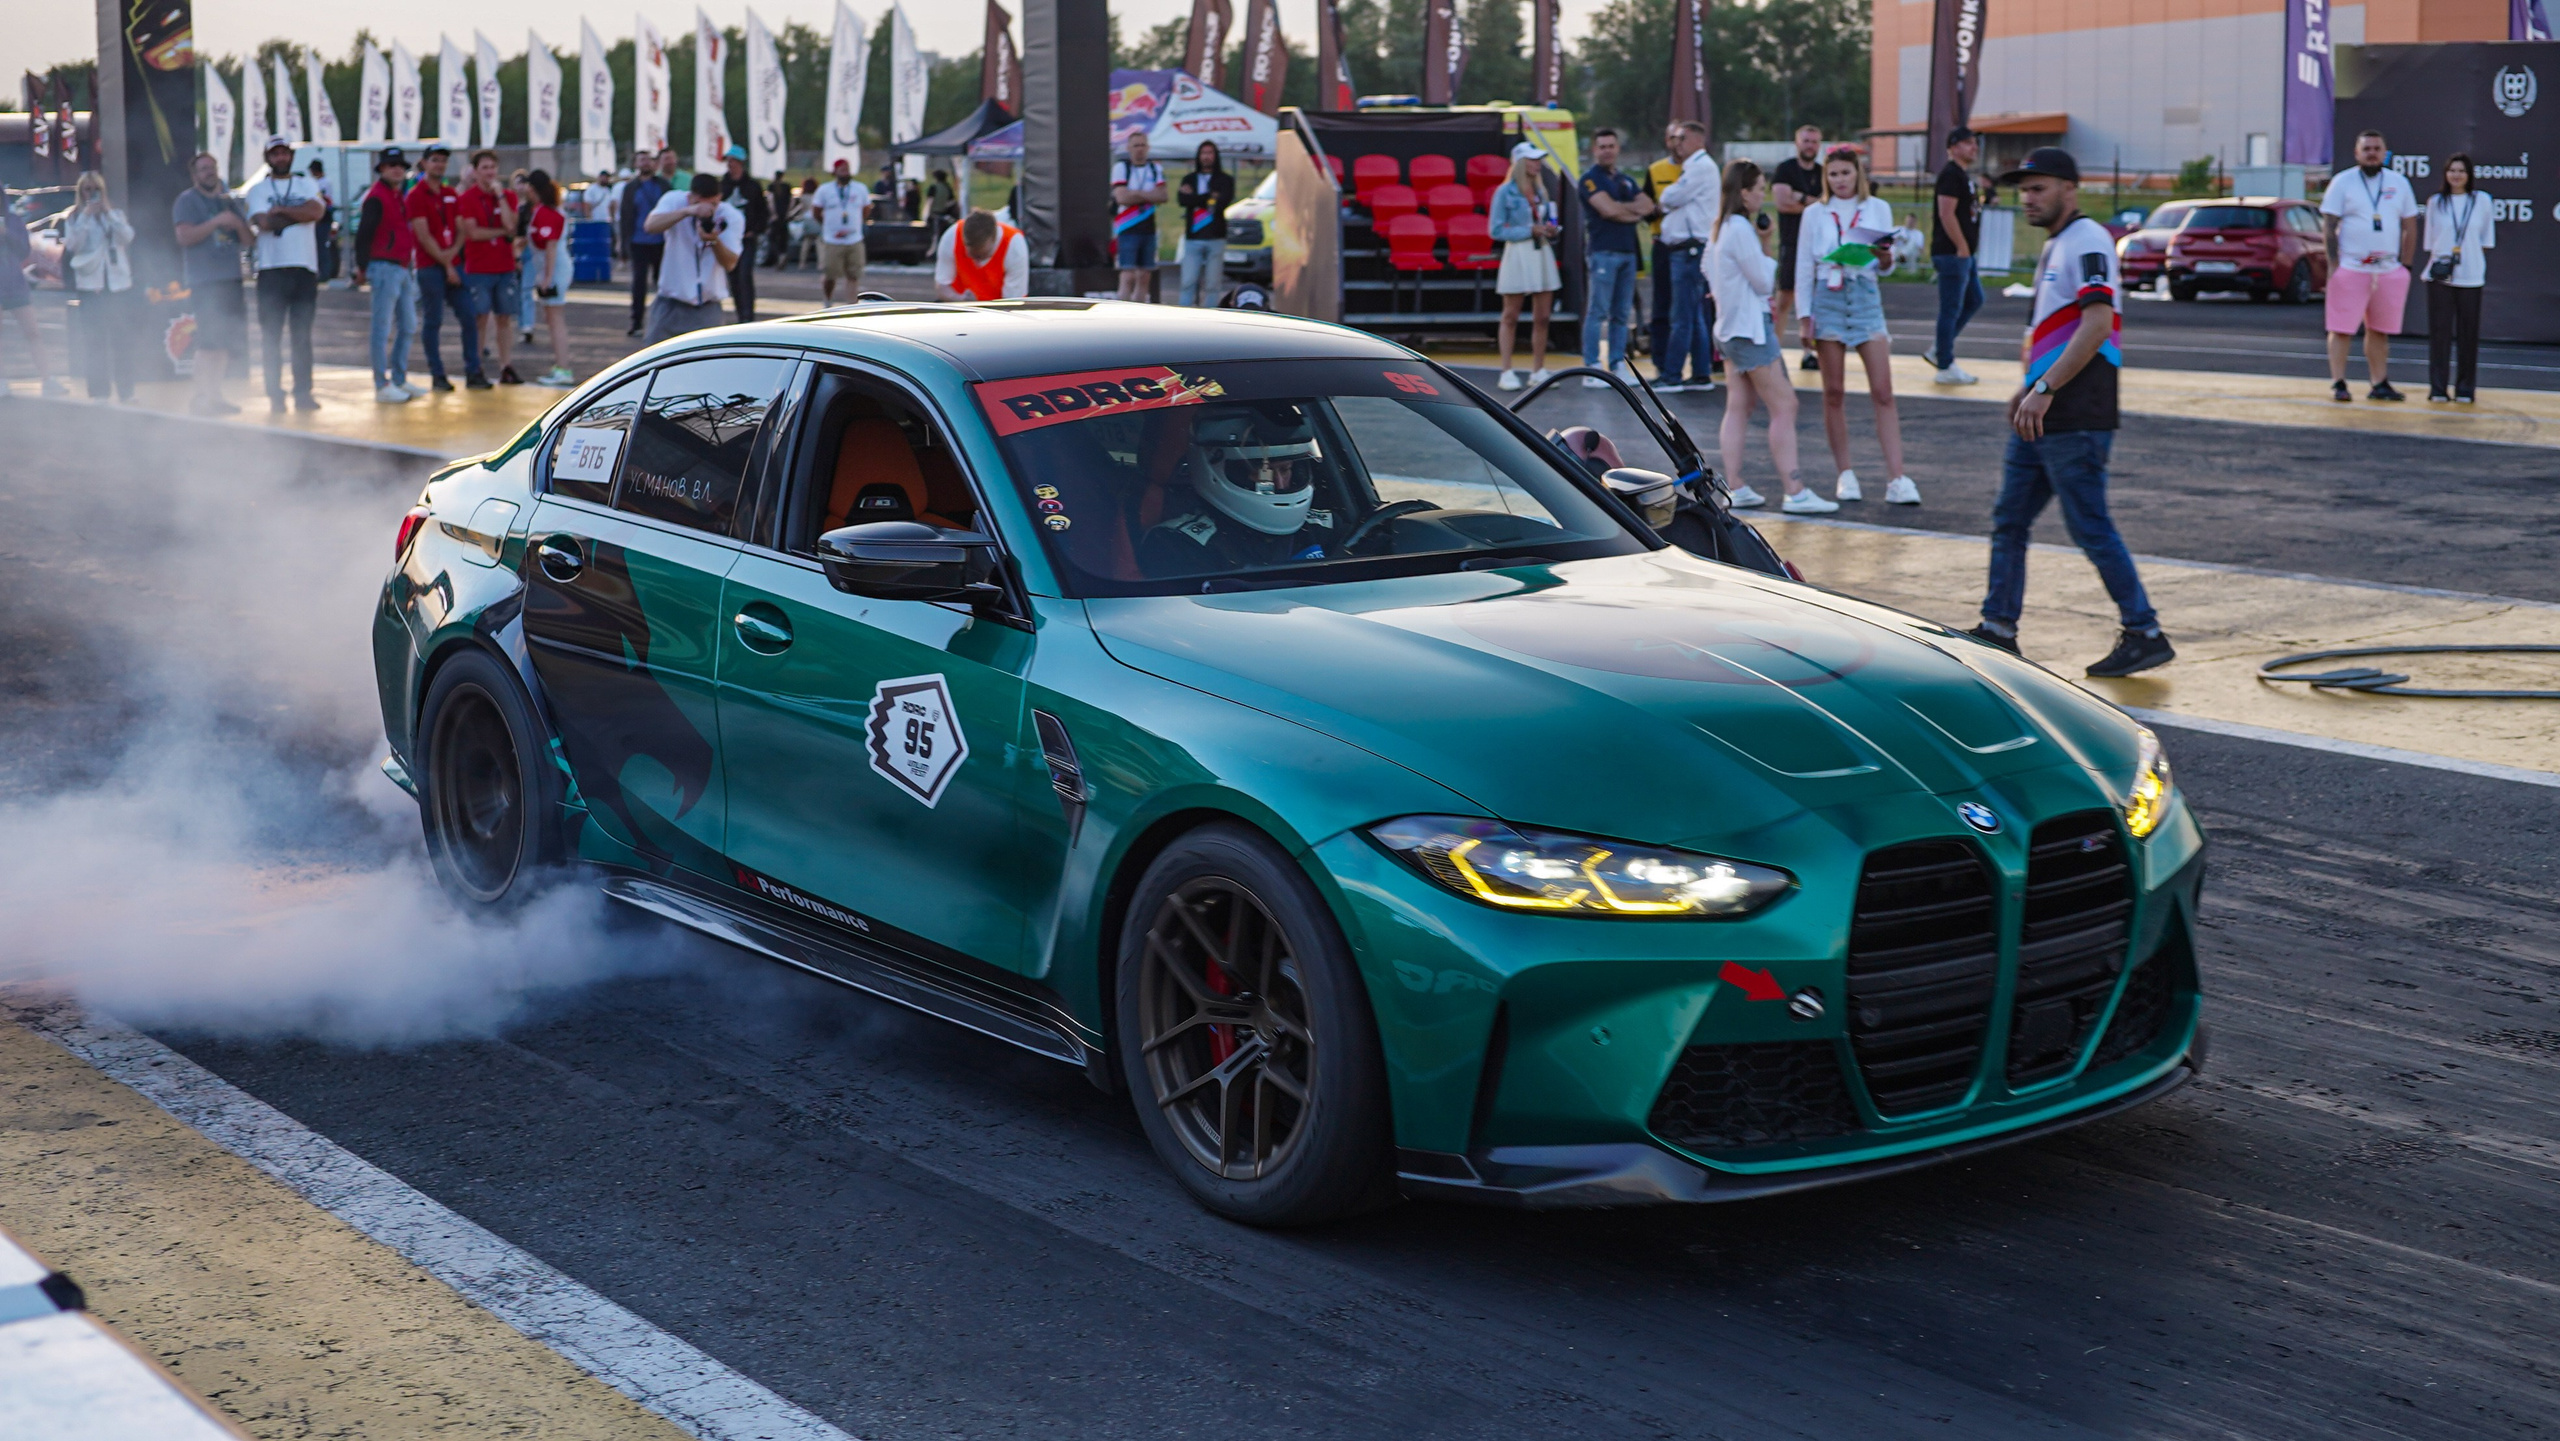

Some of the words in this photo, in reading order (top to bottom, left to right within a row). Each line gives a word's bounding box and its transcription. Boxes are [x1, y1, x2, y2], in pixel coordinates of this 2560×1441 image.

[2392, 154, 2431, 178] ВТБ
[2493, 198, 2533, 222] ВТБ
[1382, 371, 1440, 396] 95
[1000, 377, 1167, 421] RDRC
[579, 445, 606, 469] ВТБ
[628, 469, 686, 498] УСМАНОВ
[902, 701, 926, 717] RDRC
[904, 718, 935, 759] 95
